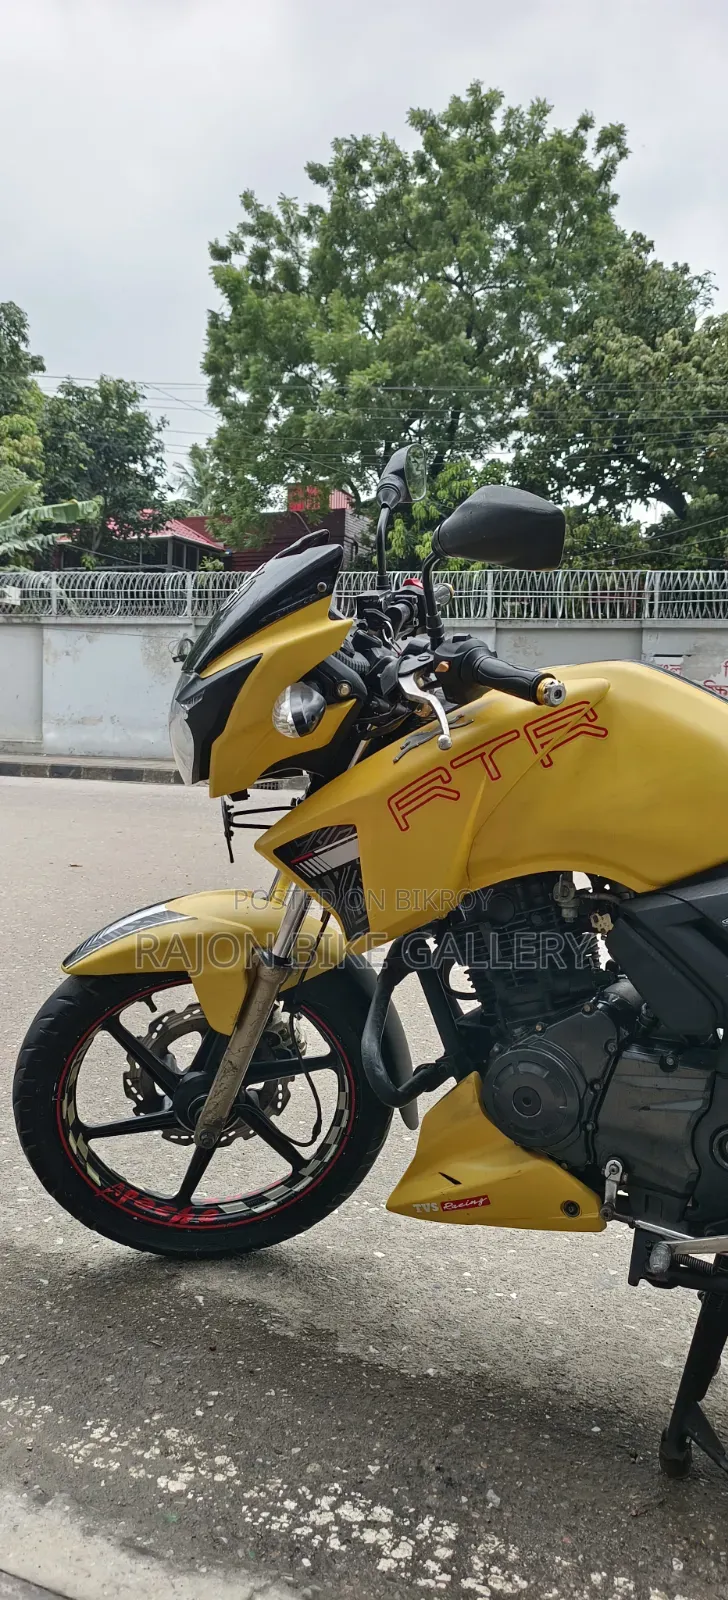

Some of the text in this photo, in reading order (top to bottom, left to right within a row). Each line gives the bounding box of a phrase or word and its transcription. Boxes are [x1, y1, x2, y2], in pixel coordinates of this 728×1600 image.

[387, 700, 609, 832] RTR
[412, 1197, 488, 1213] TVS Racing
